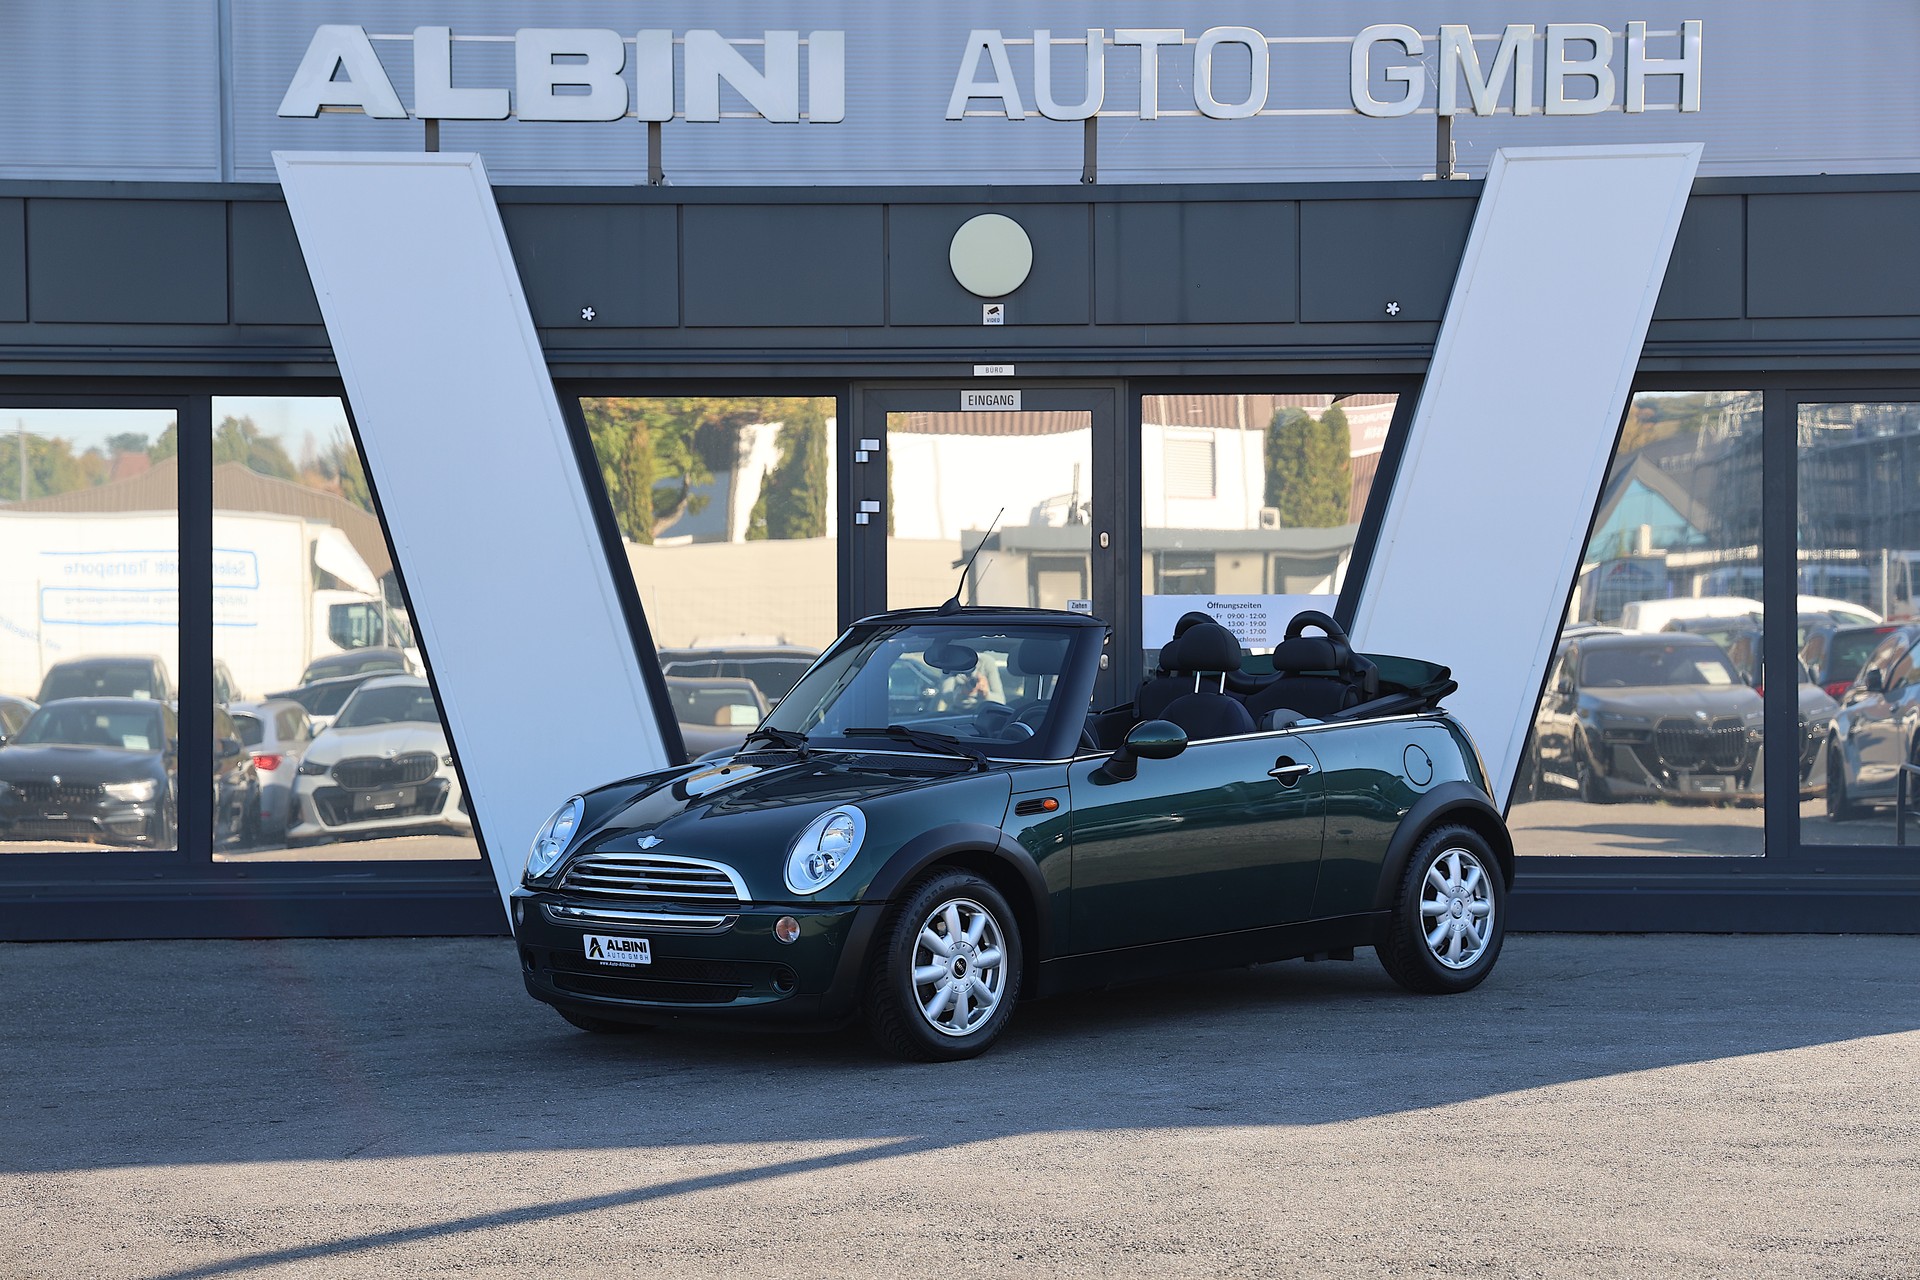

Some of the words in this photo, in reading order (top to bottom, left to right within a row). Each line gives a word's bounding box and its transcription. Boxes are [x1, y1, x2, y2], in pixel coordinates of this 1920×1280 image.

[277, 24, 846, 124] ALBINI
[945, 26, 1270, 122] AUTO
[1350, 19, 1704, 120] GMBH
[968, 394, 1014, 406] EINGANG
[1207, 601, 1262, 610] Öffnungszeiten
[607, 940, 647, 953] ALBINI
